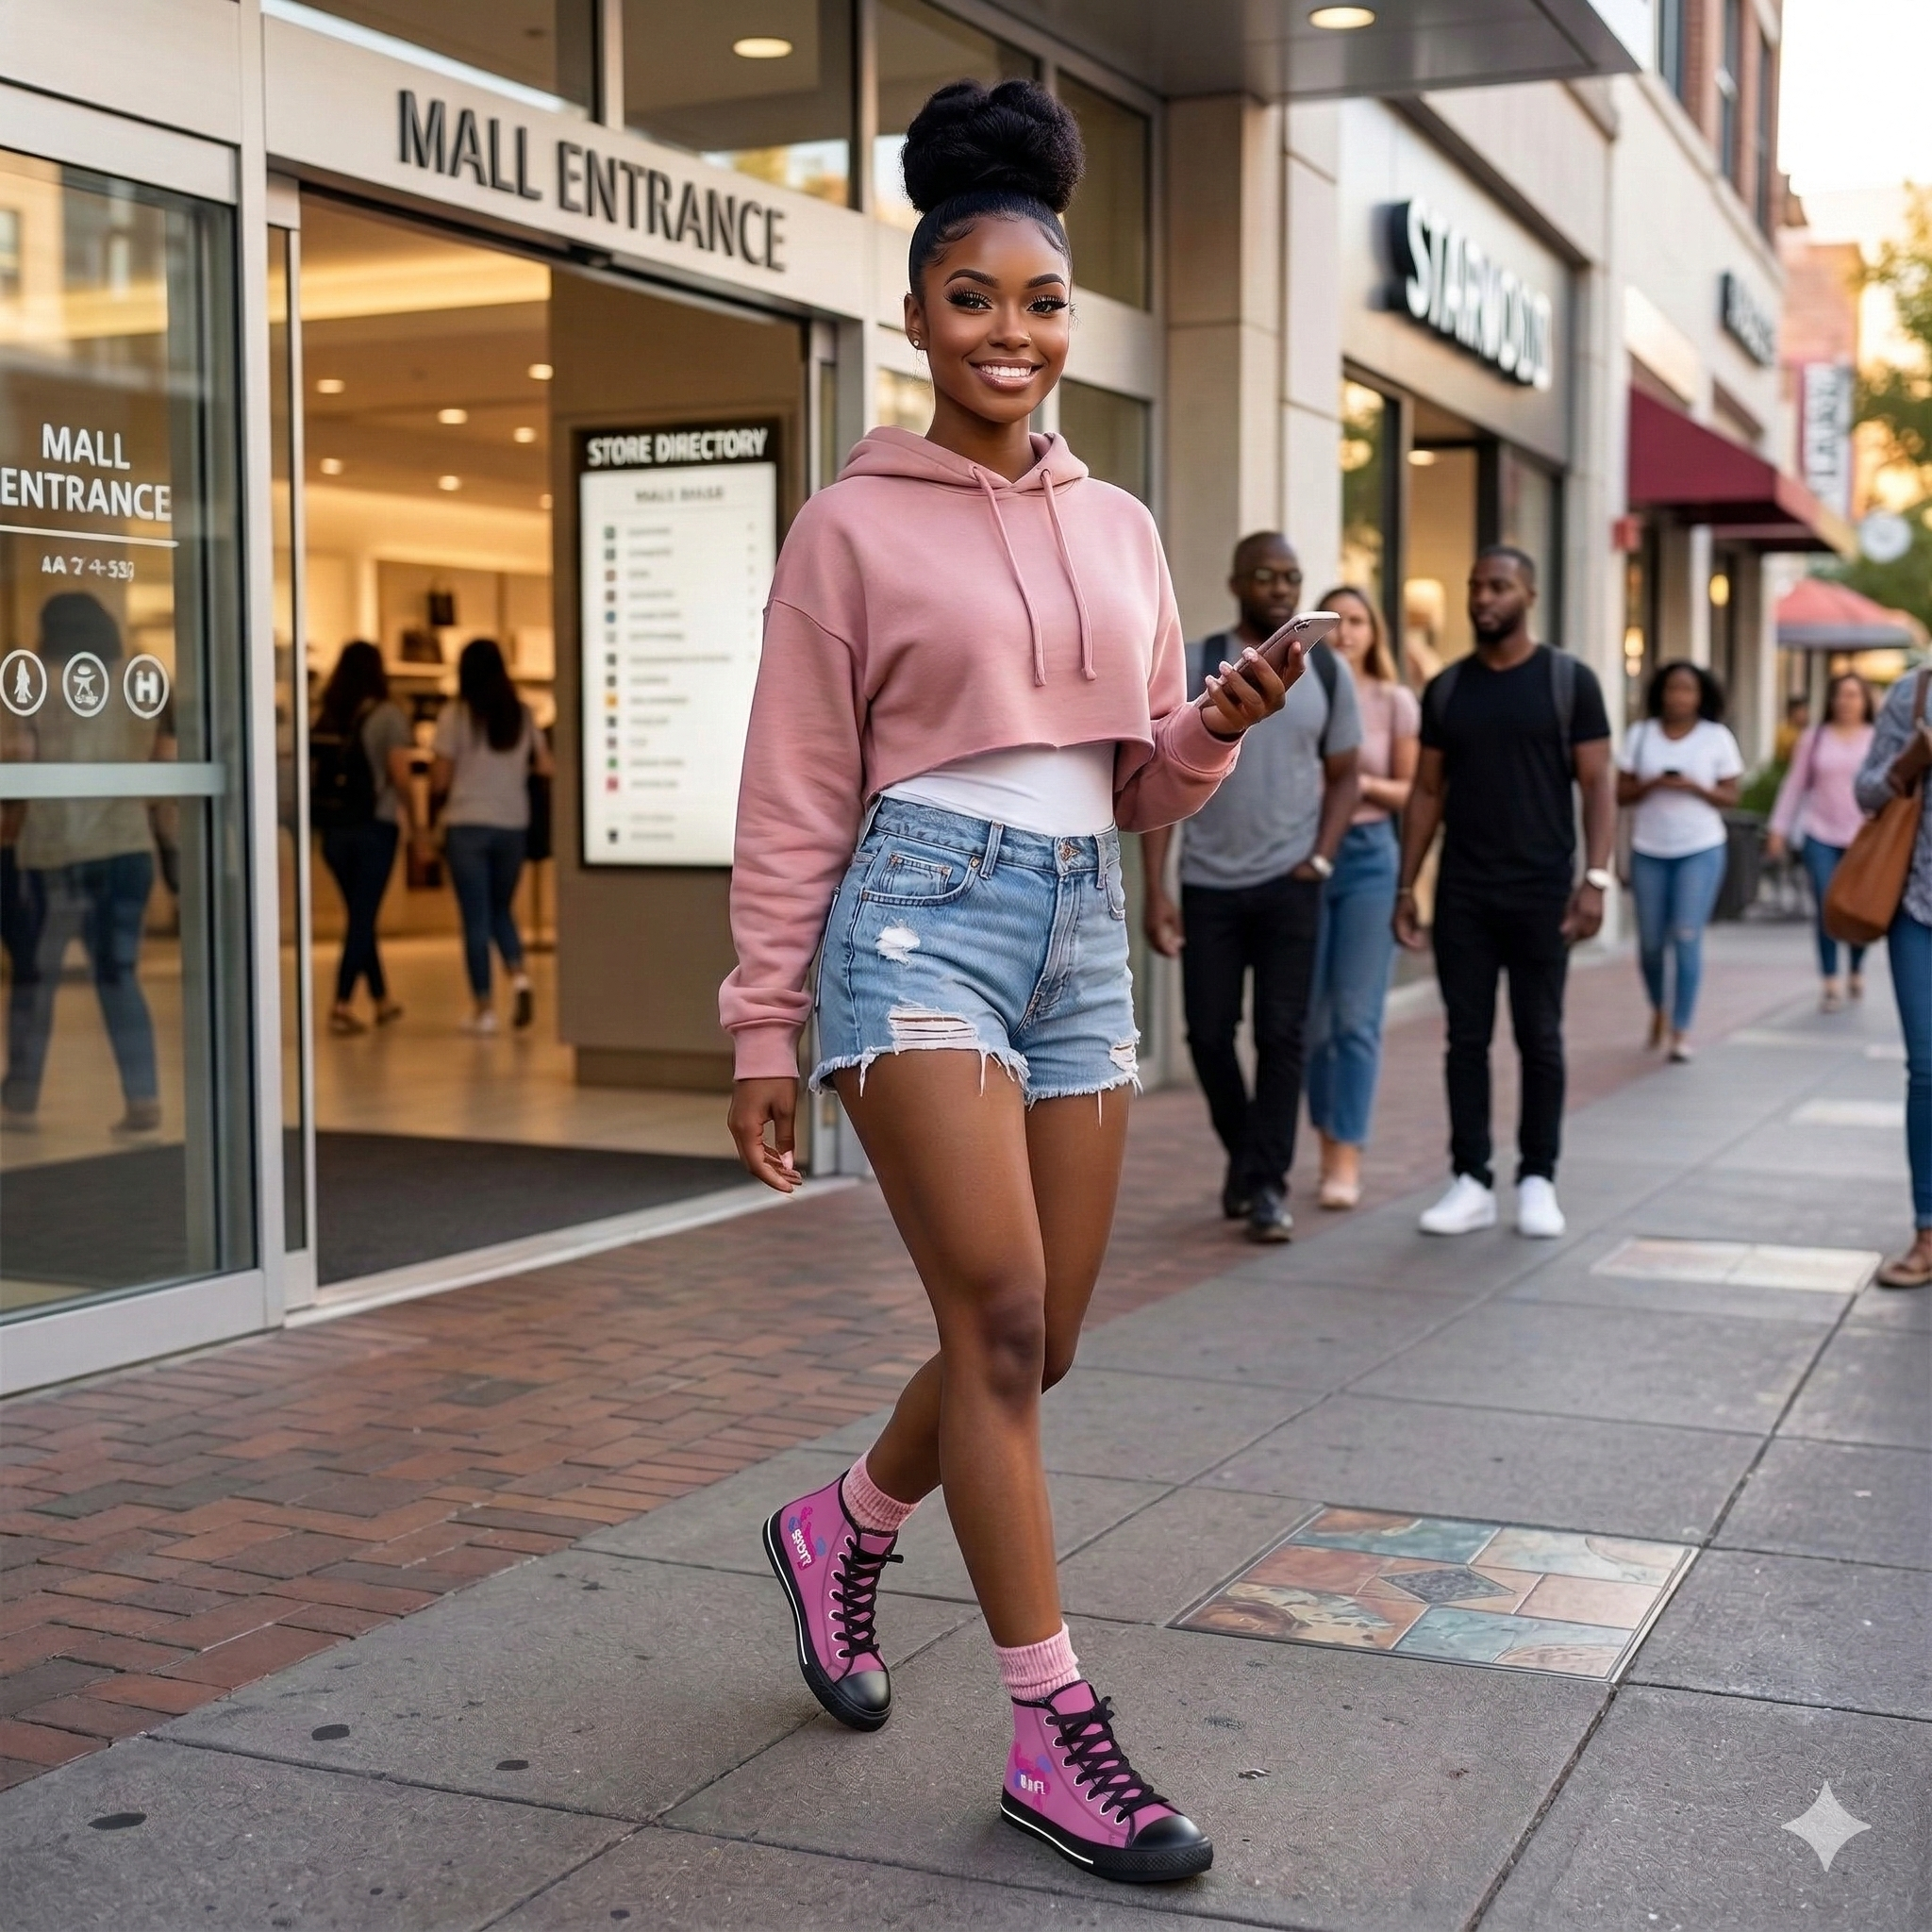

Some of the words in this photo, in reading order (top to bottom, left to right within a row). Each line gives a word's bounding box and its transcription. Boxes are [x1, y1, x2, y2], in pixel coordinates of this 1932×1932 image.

[398, 91, 542, 201] MALL
[557, 141, 786, 272] ENTRANCE
[42, 424, 131, 470] MALL
[587, 435, 652, 466] STORE
[655, 427, 768, 463] DIRECTORY
[0, 467, 173, 522] ENTRANCE
